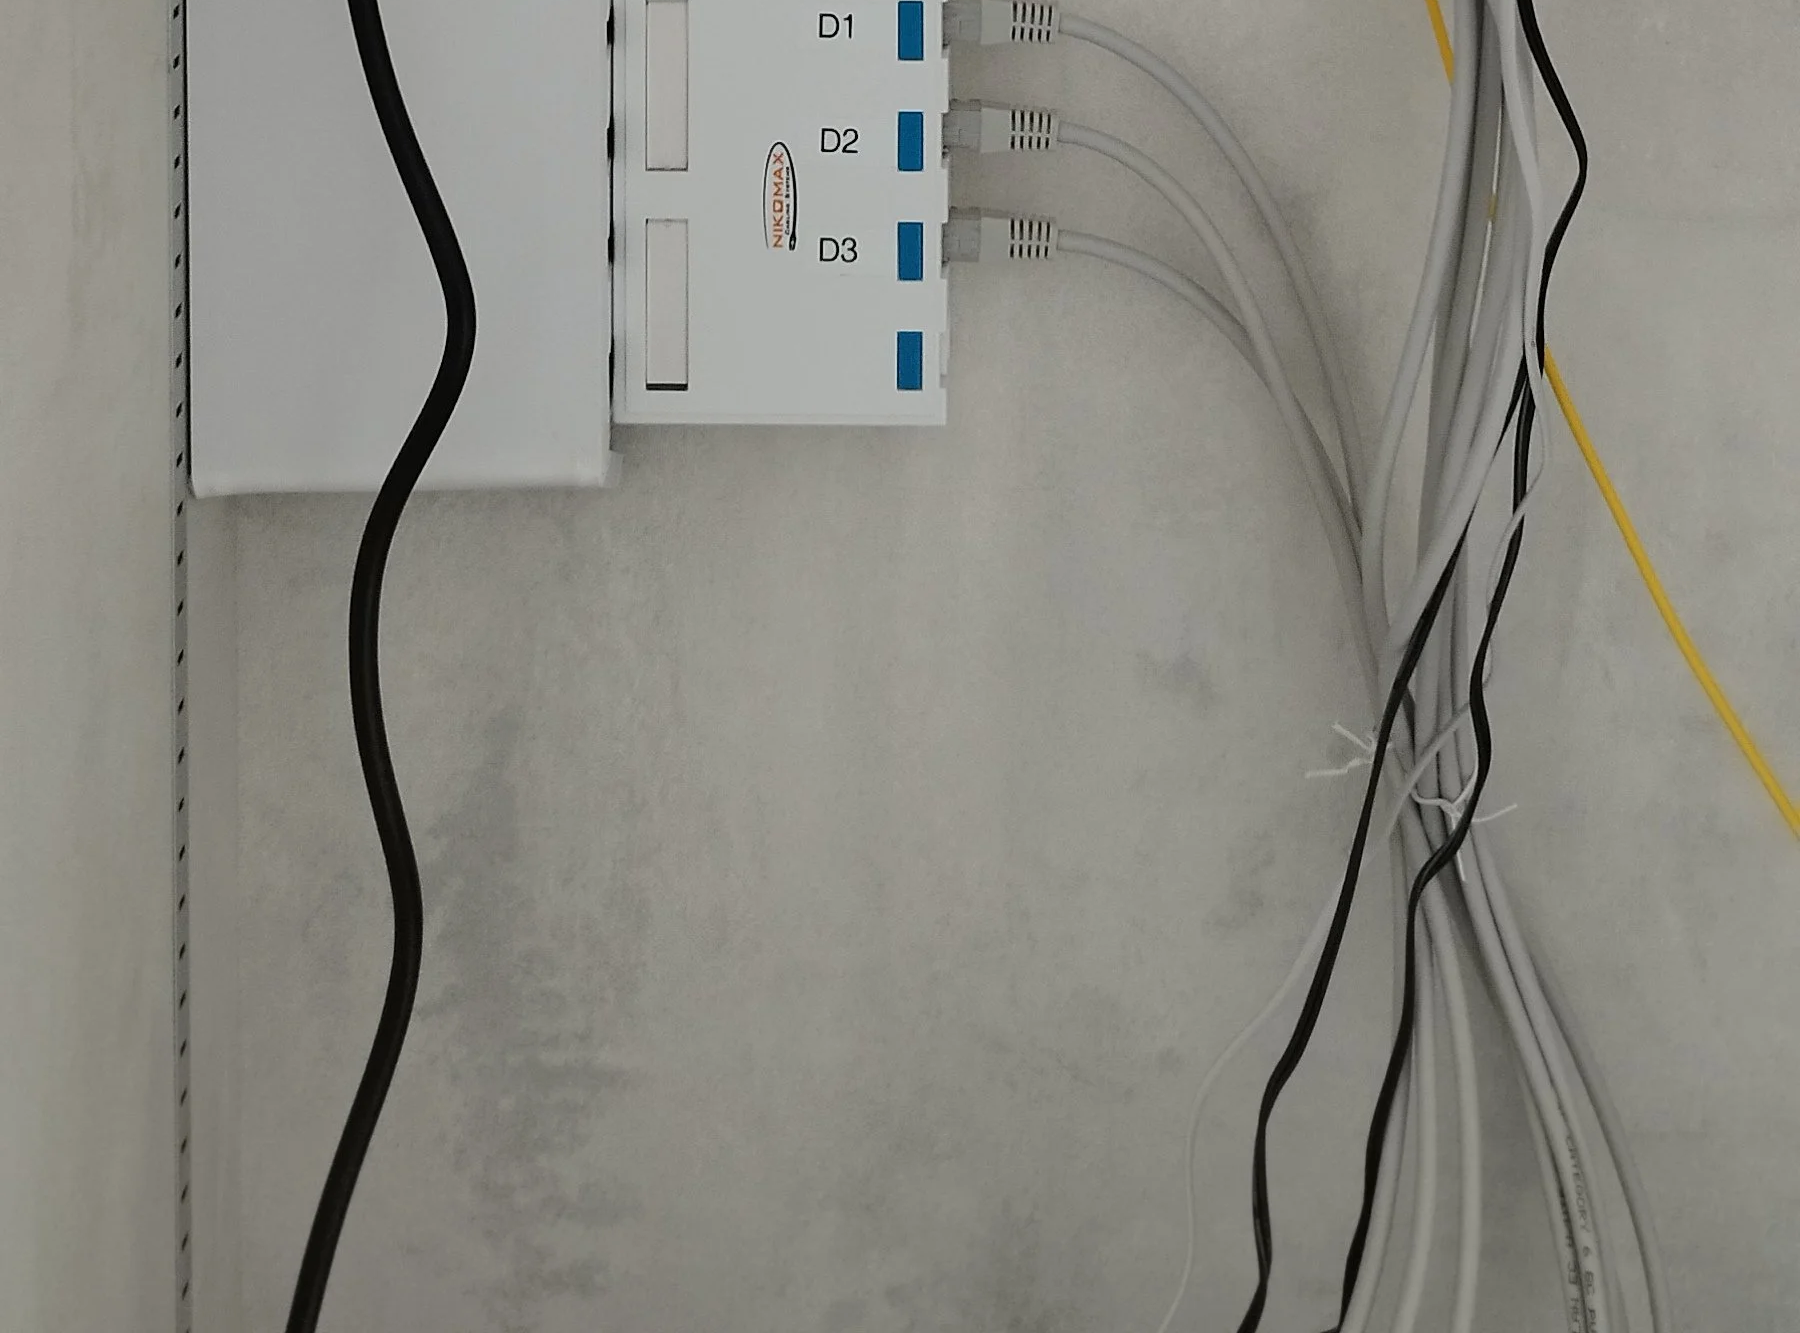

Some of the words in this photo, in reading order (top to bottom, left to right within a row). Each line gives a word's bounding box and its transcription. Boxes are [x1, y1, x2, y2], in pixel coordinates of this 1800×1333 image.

[819, 14, 852, 38] D1
[821, 128, 858, 153] D2
[772, 152, 784, 248] NIKOMAX
[820, 238, 857, 263] D3
